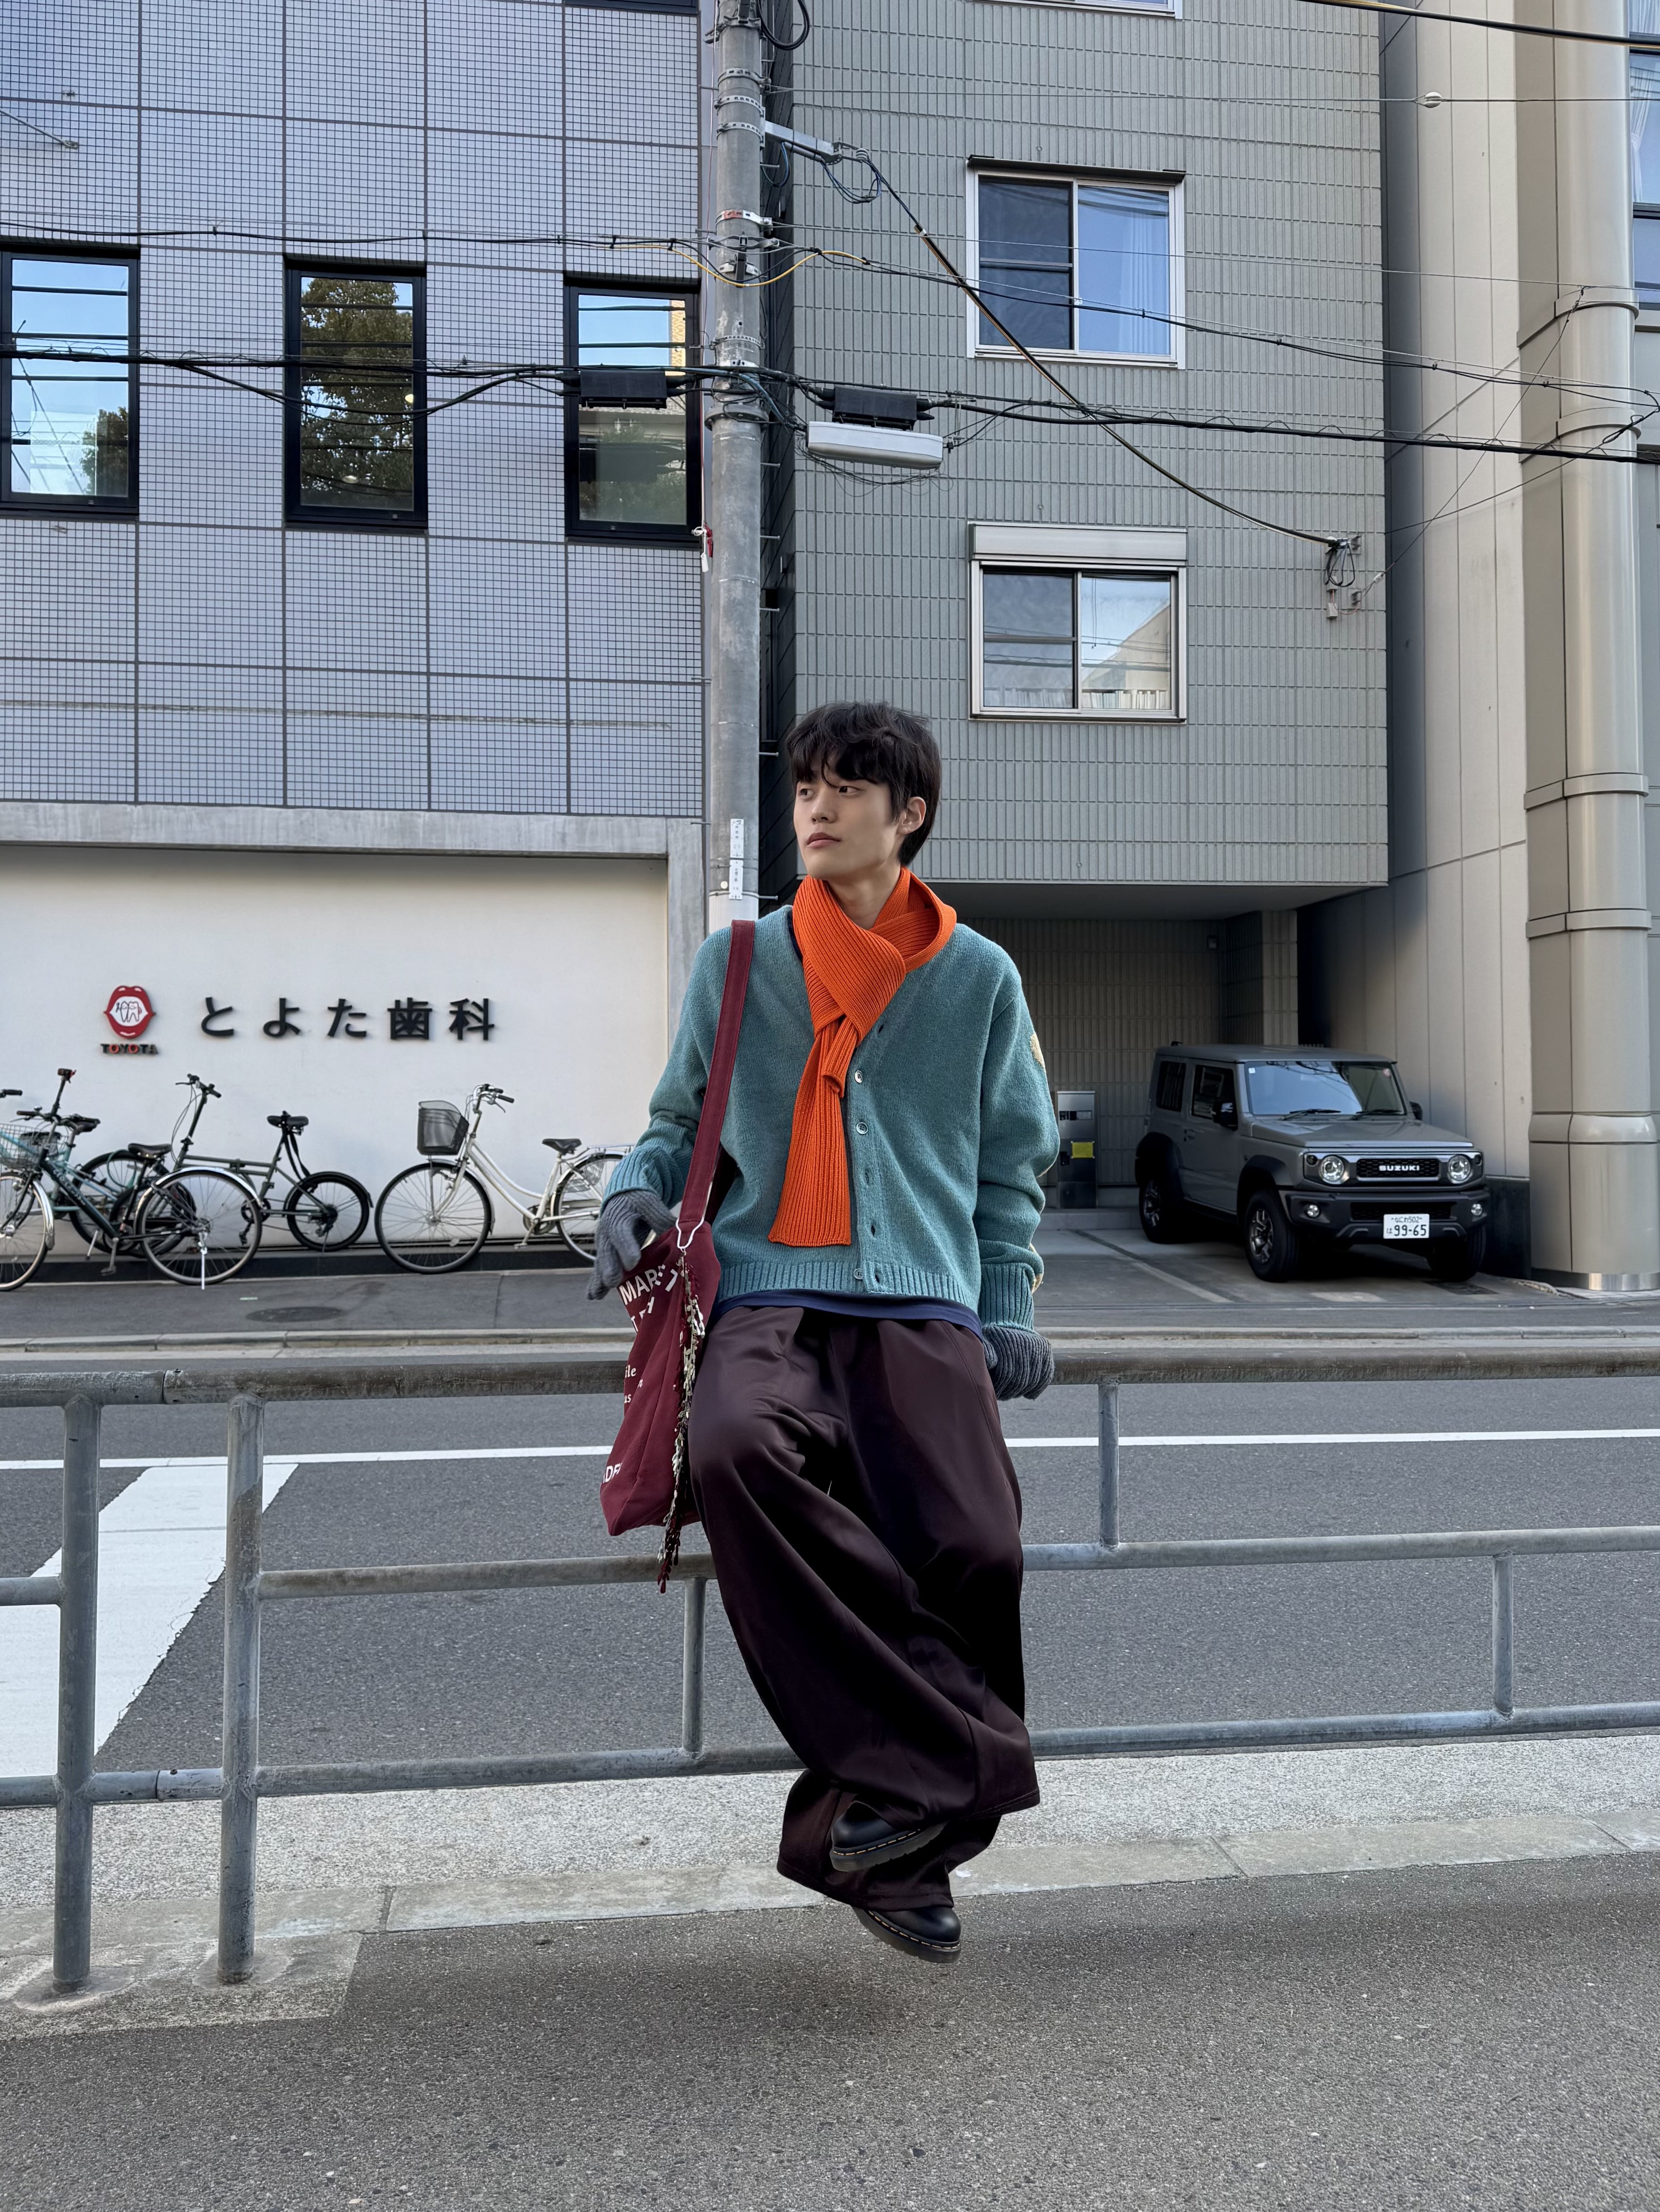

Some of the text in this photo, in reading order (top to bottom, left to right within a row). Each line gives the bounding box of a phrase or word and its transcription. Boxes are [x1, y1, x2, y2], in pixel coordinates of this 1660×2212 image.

[201, 997, 495, 1040] とよた歯科
[100, 1044, 158, 1054] TOYOTA
[1394, 1224, 1426, 1236] 99-65
